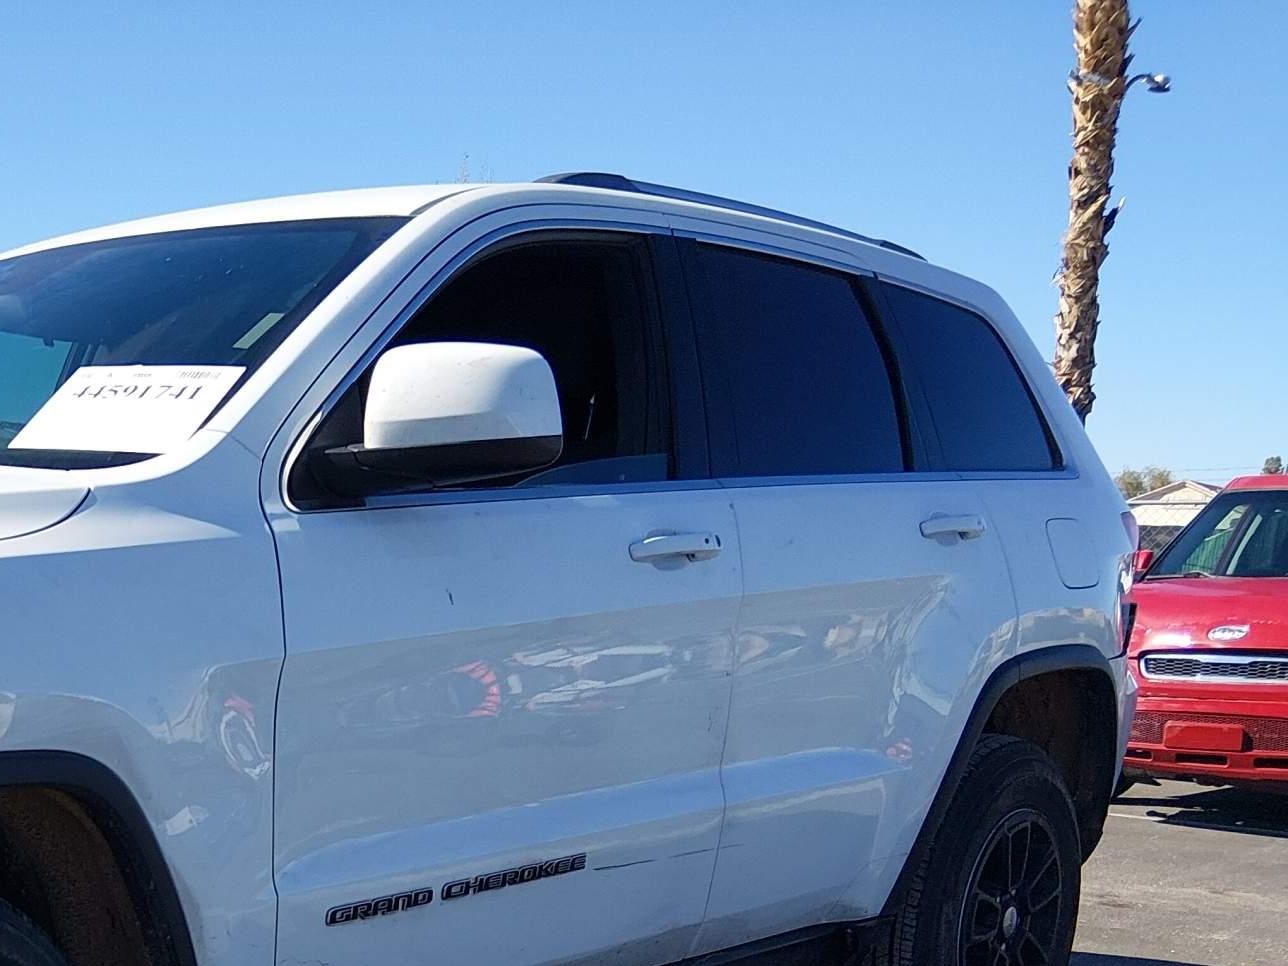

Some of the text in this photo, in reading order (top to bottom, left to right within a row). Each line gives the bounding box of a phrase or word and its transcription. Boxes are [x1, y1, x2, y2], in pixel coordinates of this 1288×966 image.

[73, 384, 203, 400] 44591741
[325, 852, 587, 926] GRAND CHEROKEE
